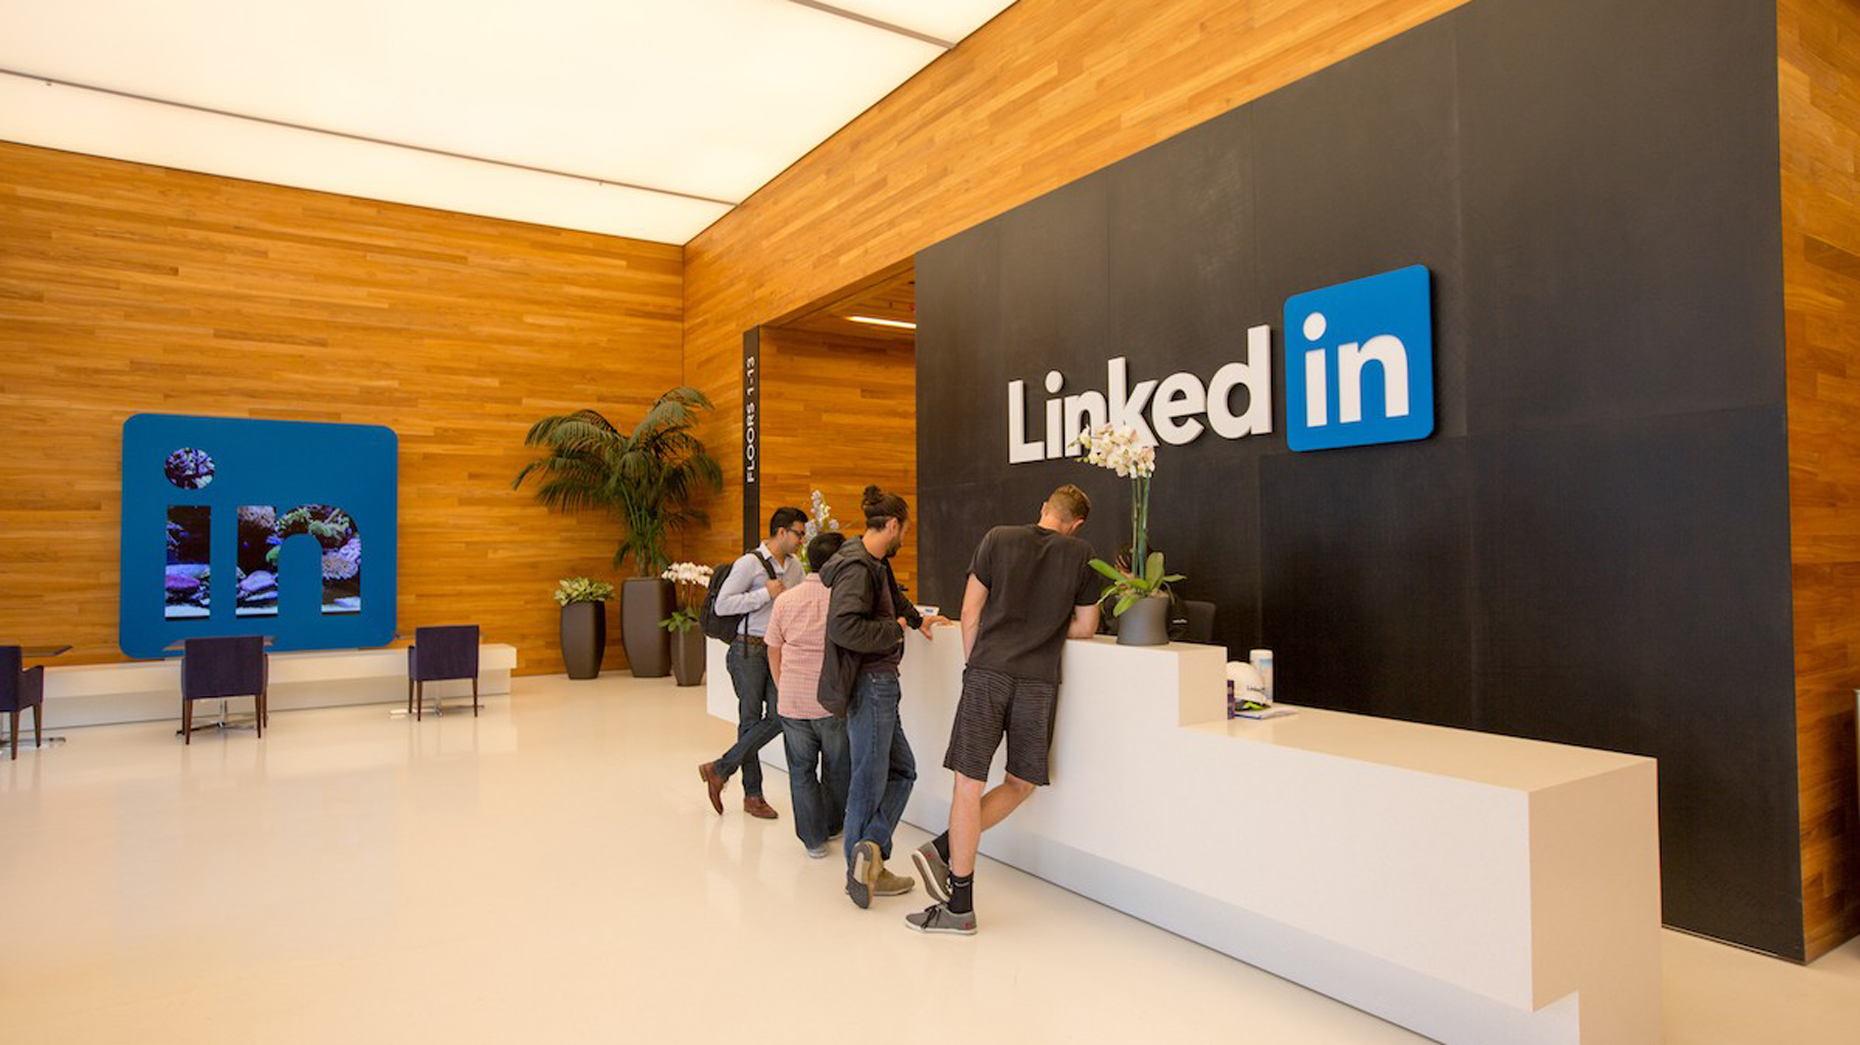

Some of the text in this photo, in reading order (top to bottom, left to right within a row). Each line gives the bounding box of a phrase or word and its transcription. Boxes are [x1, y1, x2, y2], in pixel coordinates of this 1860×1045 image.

[1303, 312, 1409, 427] in
[746, 402, 756, 483] FLOORS
[164, 447, 361, 620] in
